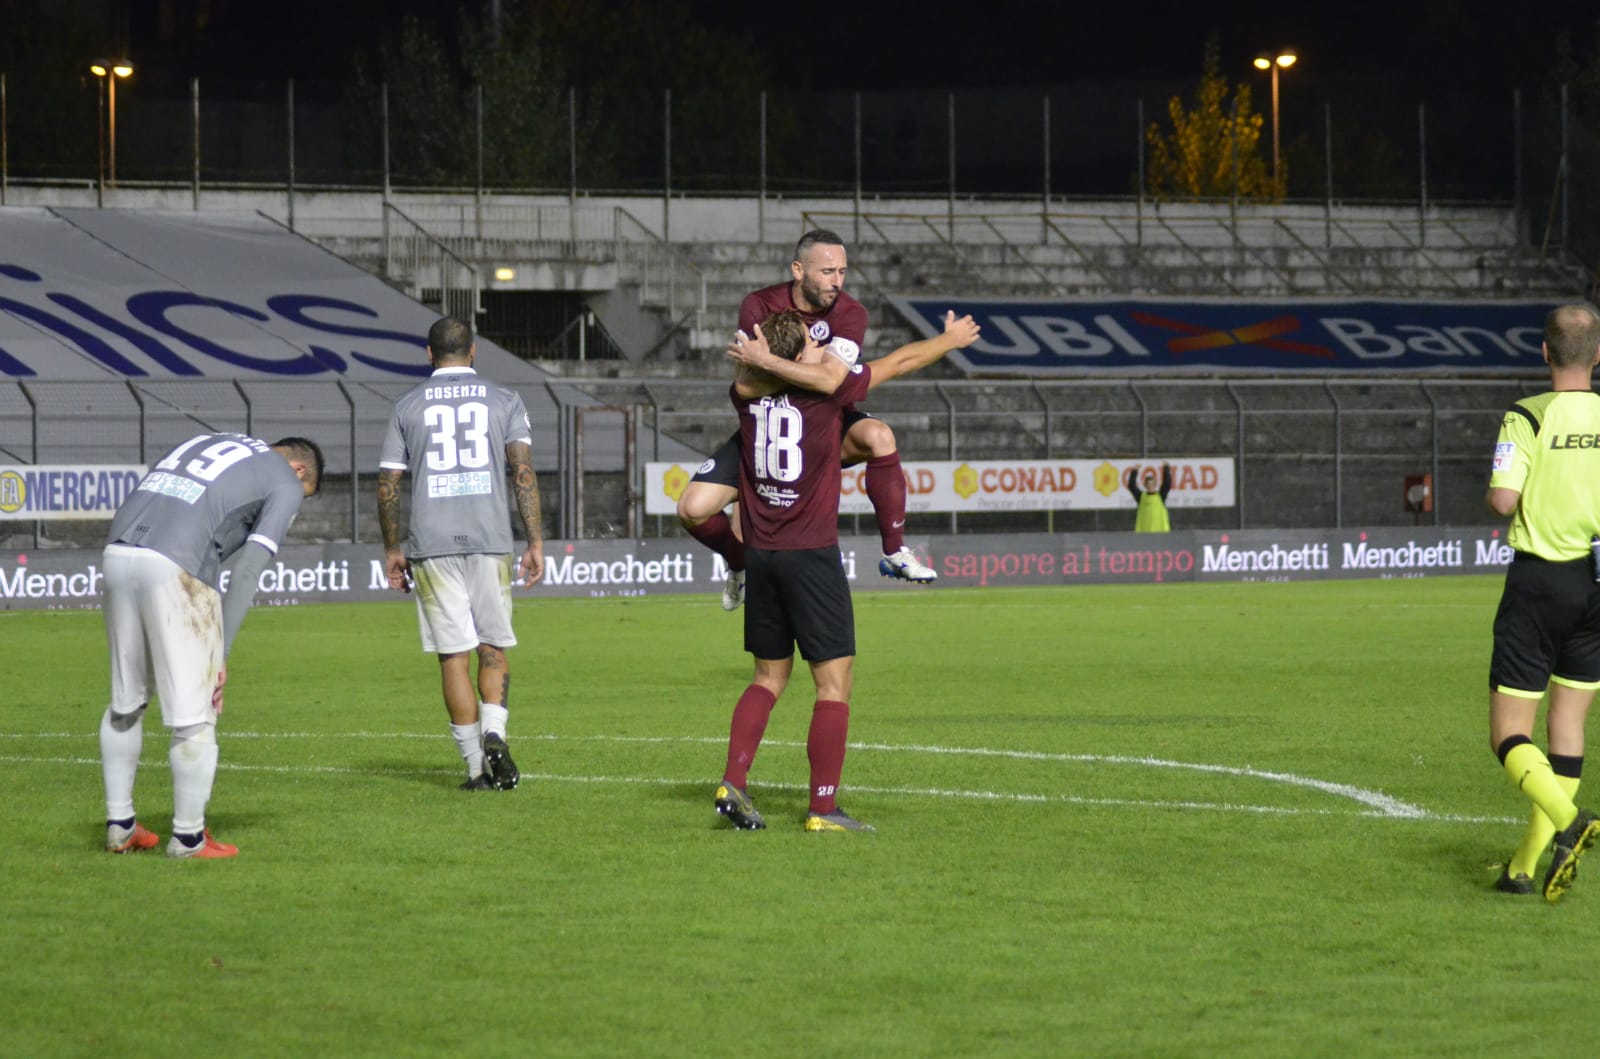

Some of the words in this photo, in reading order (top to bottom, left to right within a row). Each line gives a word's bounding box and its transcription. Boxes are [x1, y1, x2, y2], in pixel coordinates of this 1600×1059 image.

[940, 314, 1150, 356] UBI
[1319, 318, 1545, 359] Banc
[424, 384, 487, 400] COSENZA
[423, 402, 489, 471] 33
[749, 403, 802, 482] 18
[155, 434, 254, 482] 19
[25, 471, 140, 512] MERCATO
[839, 468, 936, 495] COAD
[981, 467, 1077, 493] CONAD
[543, 553, 694, 585] Menchetti
[943, 551, 1055, 586] sapore
[1062, 545, 1091, 575] al
[1099, 547, 1194, 582] tempo
[1201, 543, 1329, 572] Menchetti
[1341, 540, 1462, 568] Menchetti
[0, 565, 104, 598] Mench
